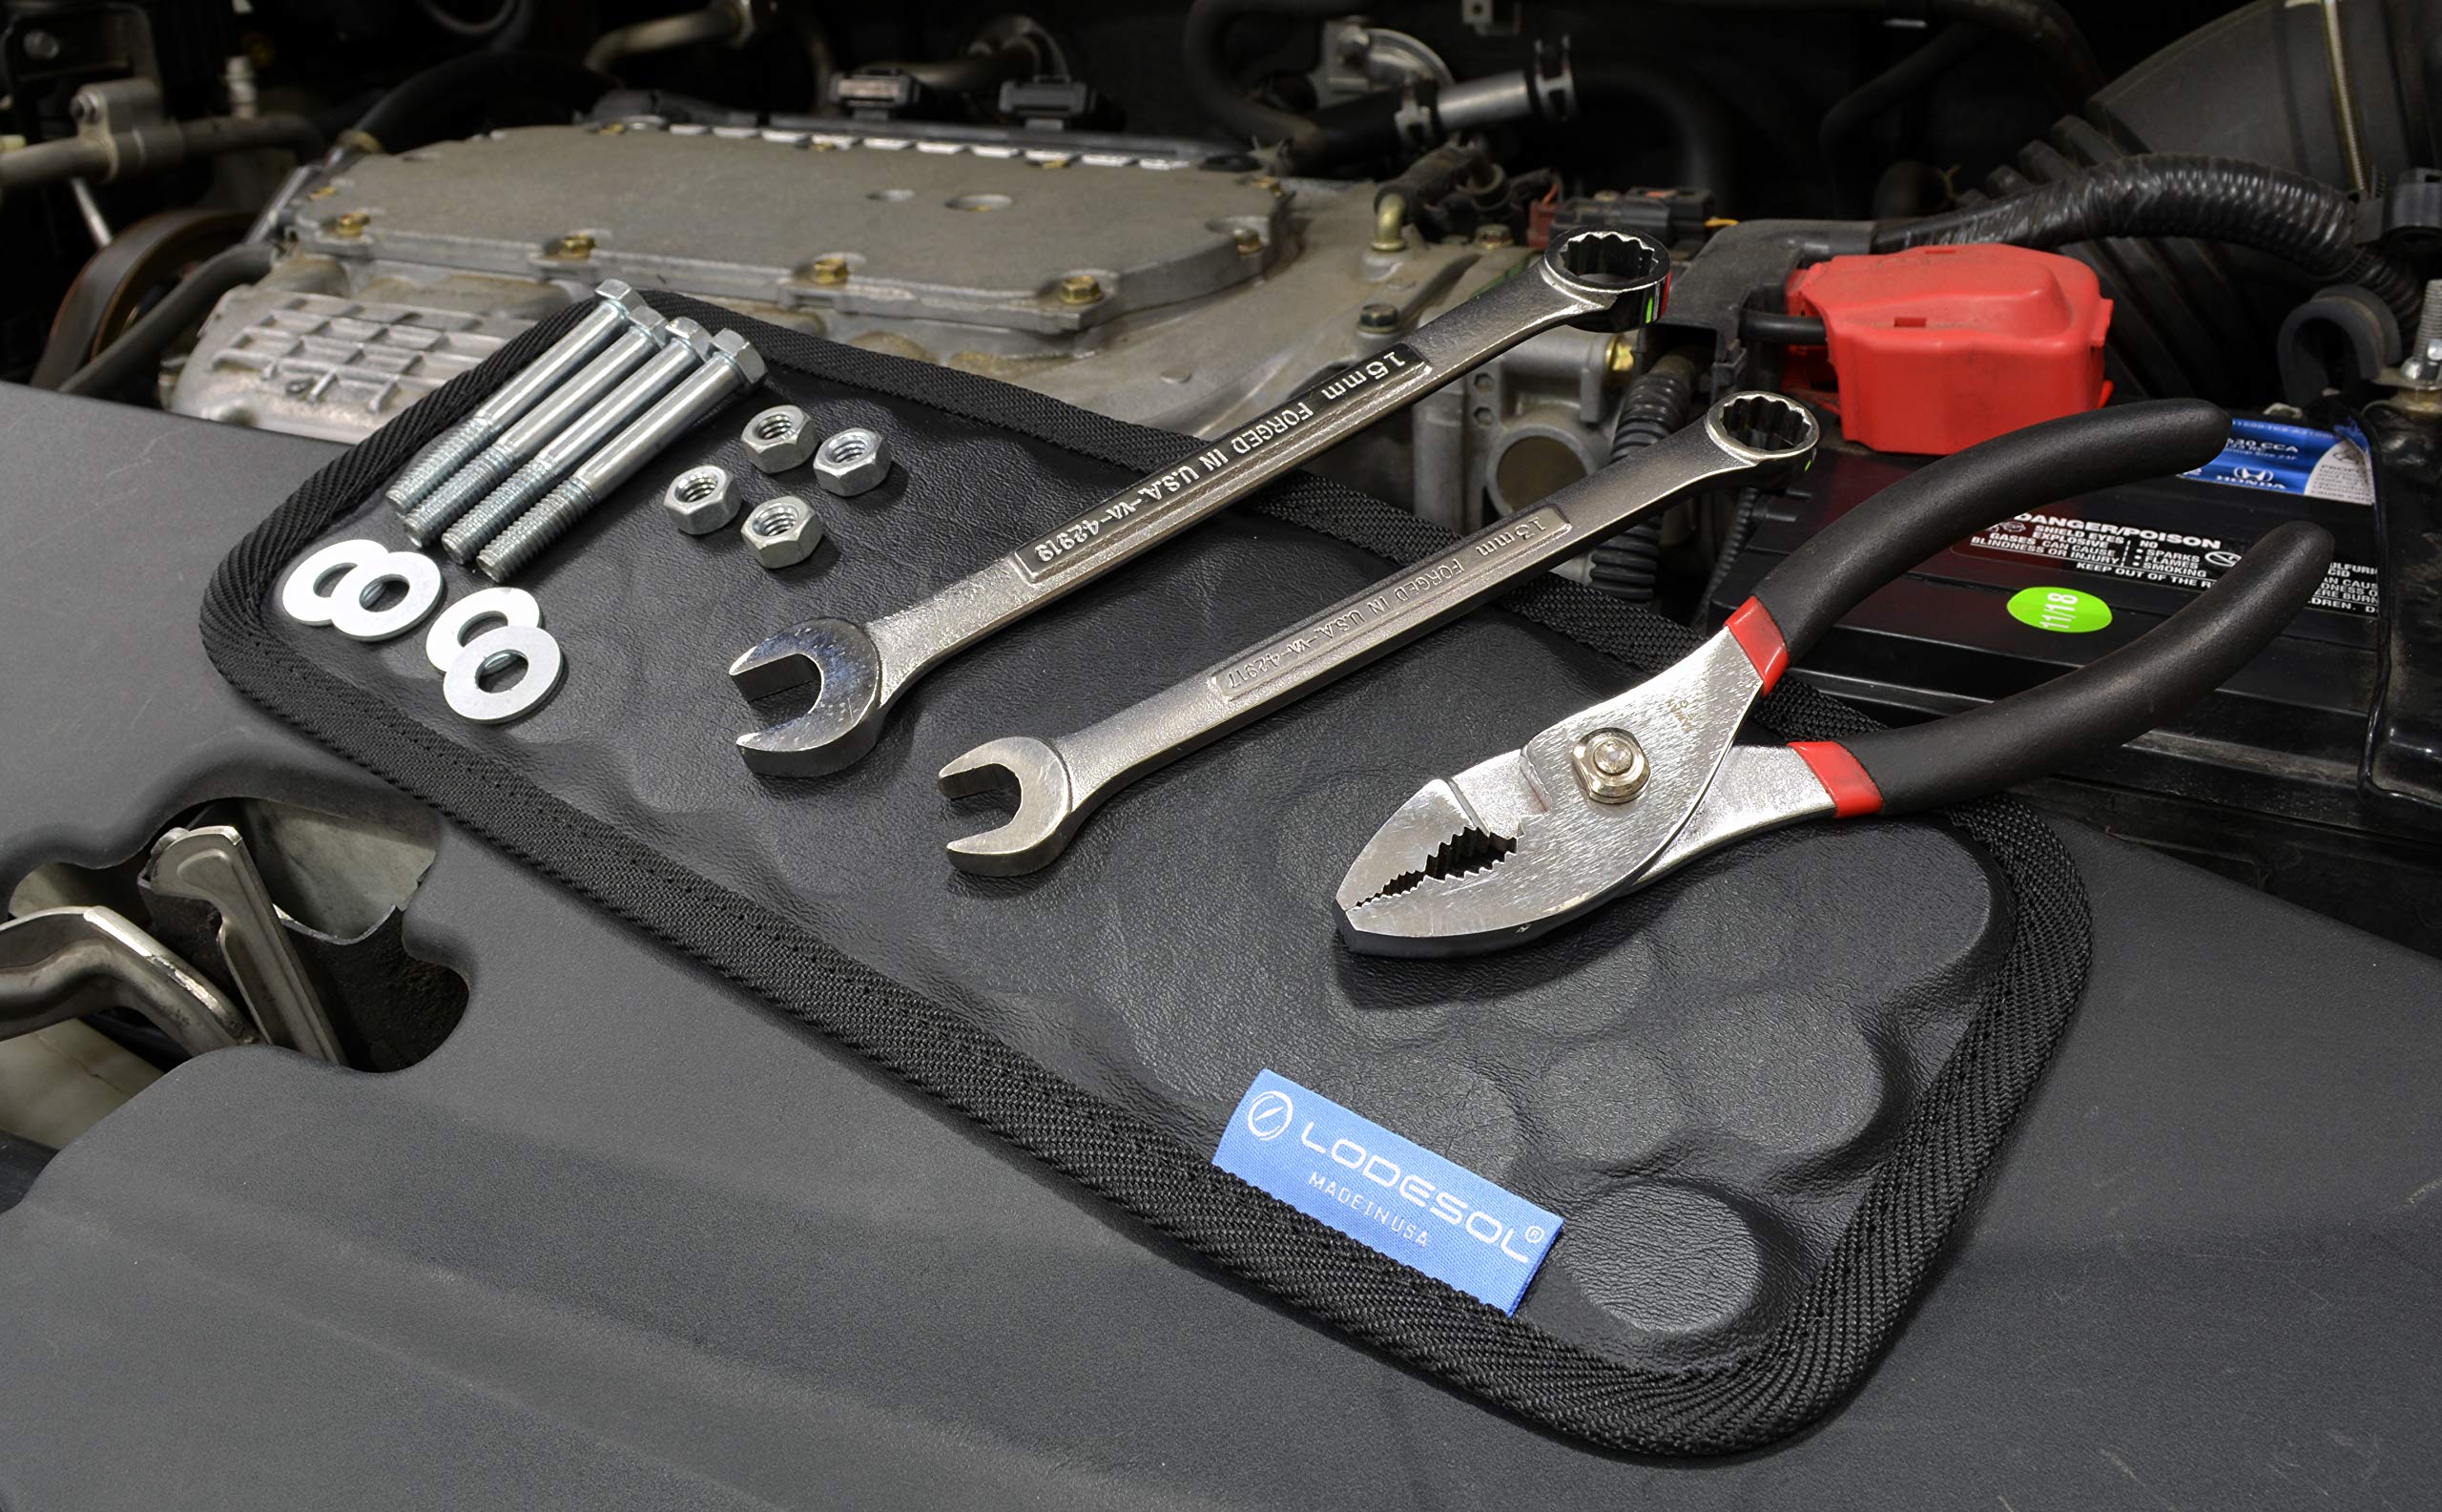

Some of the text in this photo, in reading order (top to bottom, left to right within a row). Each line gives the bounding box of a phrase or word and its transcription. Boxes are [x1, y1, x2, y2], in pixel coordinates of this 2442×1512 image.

[1231, 402, 1314, 456] FORGED
[2261, 442, 2299, 453] CCA
[1198, 448, 1229, 473] IN
[2216, 475, 2287, 489] HONDA
[2014, 512, 2221, 549] DANGER/POISON
[2036, 525, 2124, 545] SHIELD EYES
[1990, 532, 2116, 557] GASES CAN CAUSE
[2033, 531, 2109, 549] EXPLOSIVE
[2140, 540, 2158, 549] NO
[1971, 536, 2120, 565] BLINDNESS OR INJURY
[2146, 549, 2200, 563] SPARKS
[2142, 562, 2207, 578] SMOKING
[2144, 555, 2199, 570] FLAMES
[2329, 562, 2378, 574] ULFURI
[1394, 558, 1465, 603] FORGED
[2077, 562, 2112, 572] KEEP
[2115, 568, 2144, 578] OUT
[2147, 572, 2166, 581] OF
[2170, 575, 2198, 586] THE
[2328, 569, 2350, 577] CID
[2321, 582, 2365, 594] DNESS
[2343, 579, 2378, 590] CAUS
[2309, 597, 2356, 611] DREN.
[2314, 588, 2379, 604] ERE BURN
[1367, 595, 1390, 616] IN
[2039, 592, 2079, 629] 11/18
